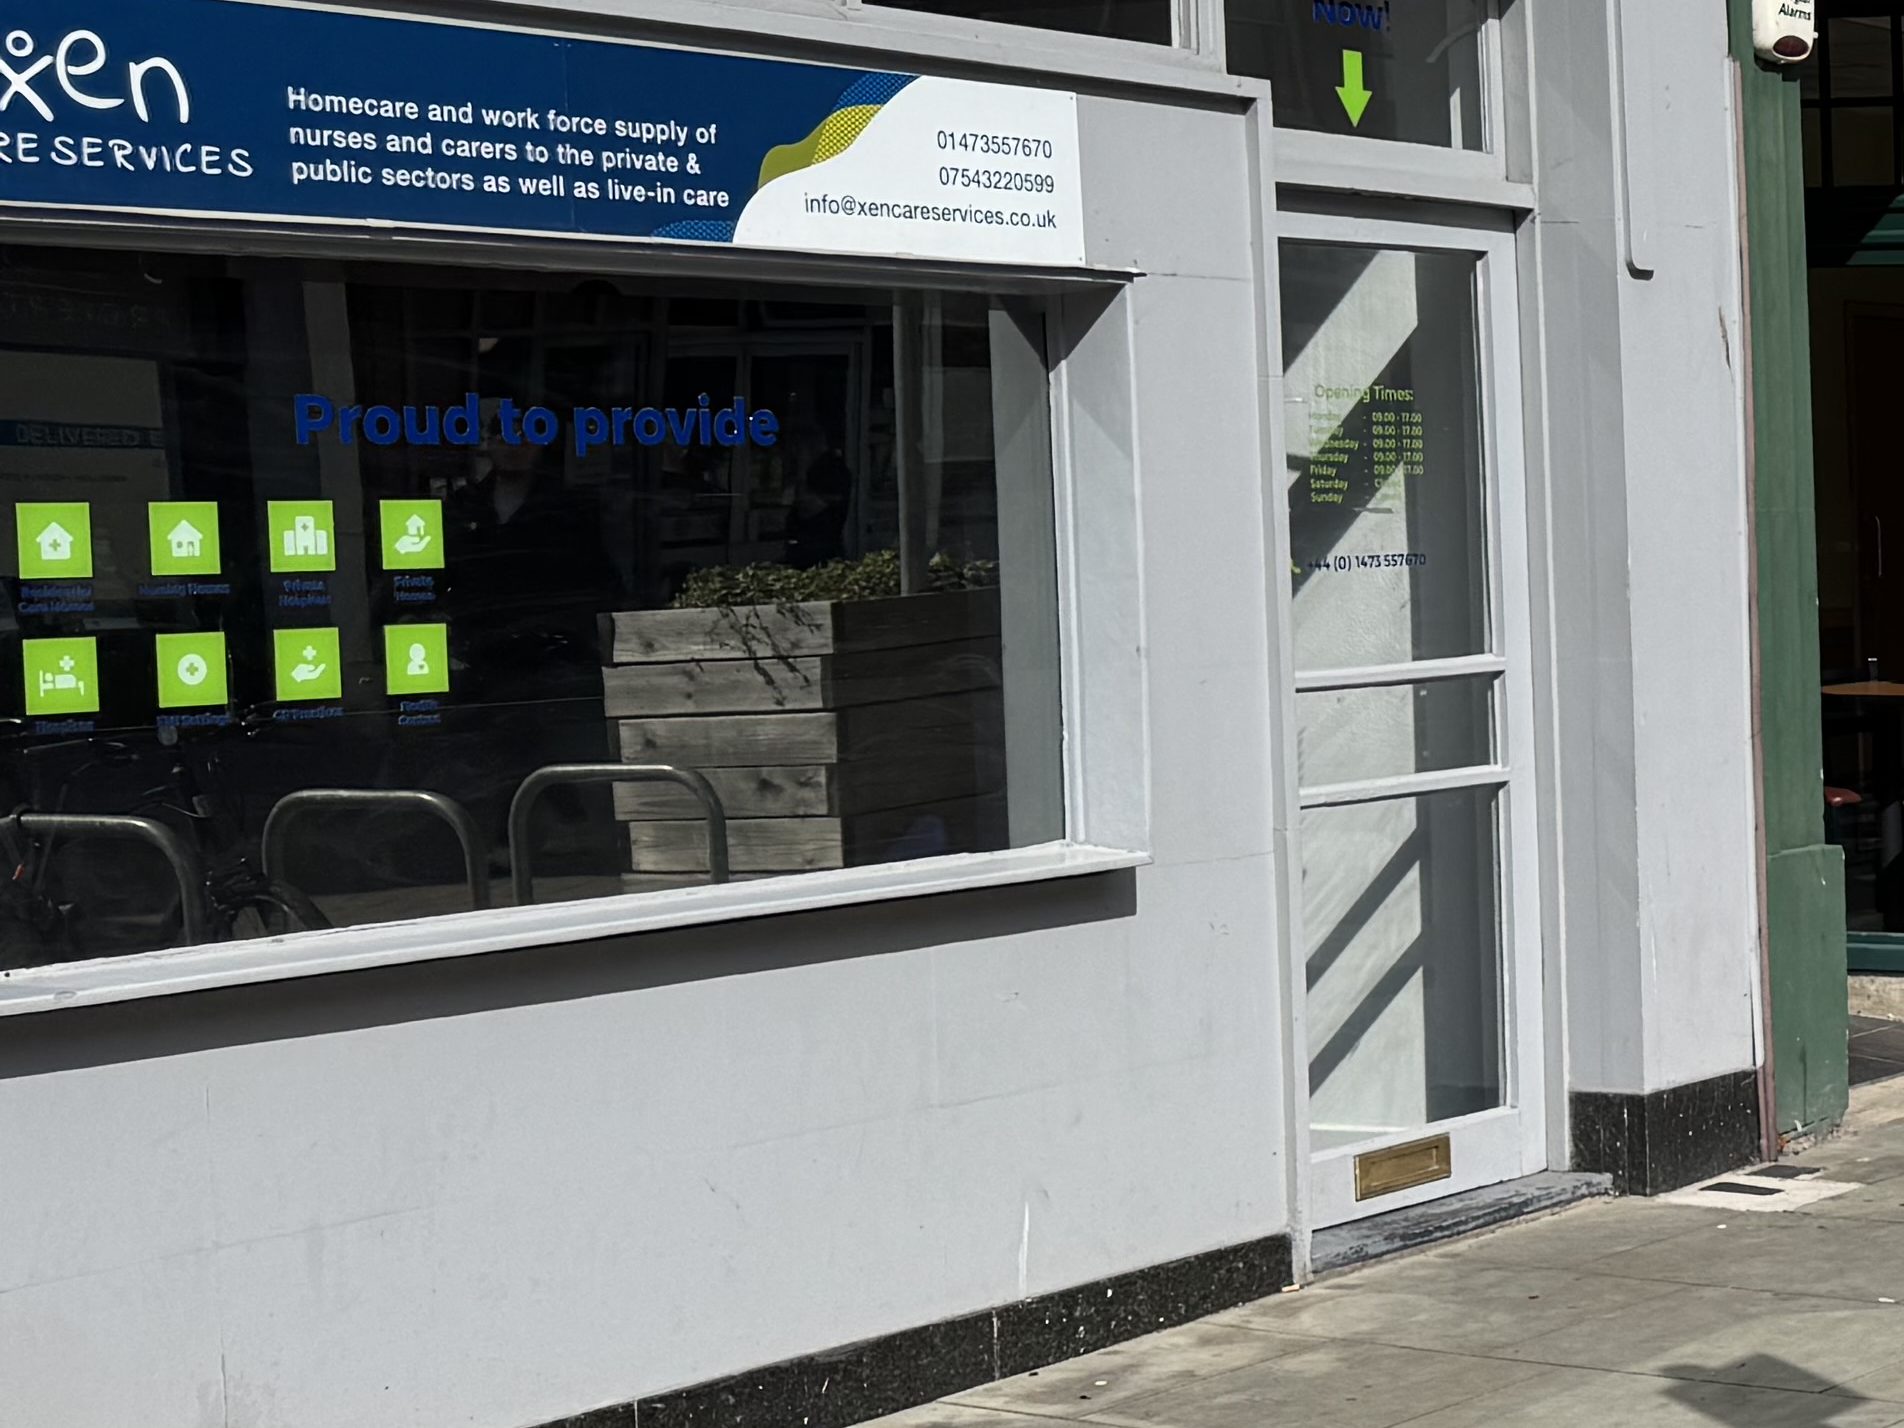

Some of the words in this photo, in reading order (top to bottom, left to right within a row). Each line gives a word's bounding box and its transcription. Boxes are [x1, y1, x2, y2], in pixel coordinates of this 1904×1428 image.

[1778, 3, 1811, 21] Alarms
[287, 86, 419, 120] Homecare
[428, 102, 473, 124] and
[482, 107, 540, 128] work
[547, 109, 607, 135] force
[615, 120, 688, 147] supply
[696, 123, 717, 144] of
[51, 136, 253, 177] SERVICES
[289, 126, 377, 150] nurses
[386, 132, 432, 154] and
[441, 138, 517, 161] carers
[525, 141, 548, 163] to
[557, 143, 594, 166] the
[602, 148, 679, 172] private
[686, 152, 701, 174] &
[937, 130, 1052, 158] 01473557670
[292, 159, 373, 185] public
[382, 167, 475, 191] sectors
[483, 175, 511, 193] as
[519, 175, 565, 197] well
[573, 180, 600, 199] as
[608, 179, 675, 204] live-in
[683, 188, 729, 207] care
[939, 166, 1054, 193] 07543220599
[804, 192, 1057, 229] info@xencareservices.co.uk
[1314, 385, 1370, 403] Opening
[1373, 386, 1414, 402] Times:
[294, 392, 480, 447] Proud
[499, 395, 557, 446] to
[575, 394, 780, 457] provide
[1310, 465, 1337, 476] Friday
[1310, 479, 1348, 490] Saturday
[1311, 492, 1343, 504] Sunday
[1334, 556, 1351, 572] (0)
[1355, 555, 1381, 568] 1473
[1384, 553, 1426, 567] 557670
